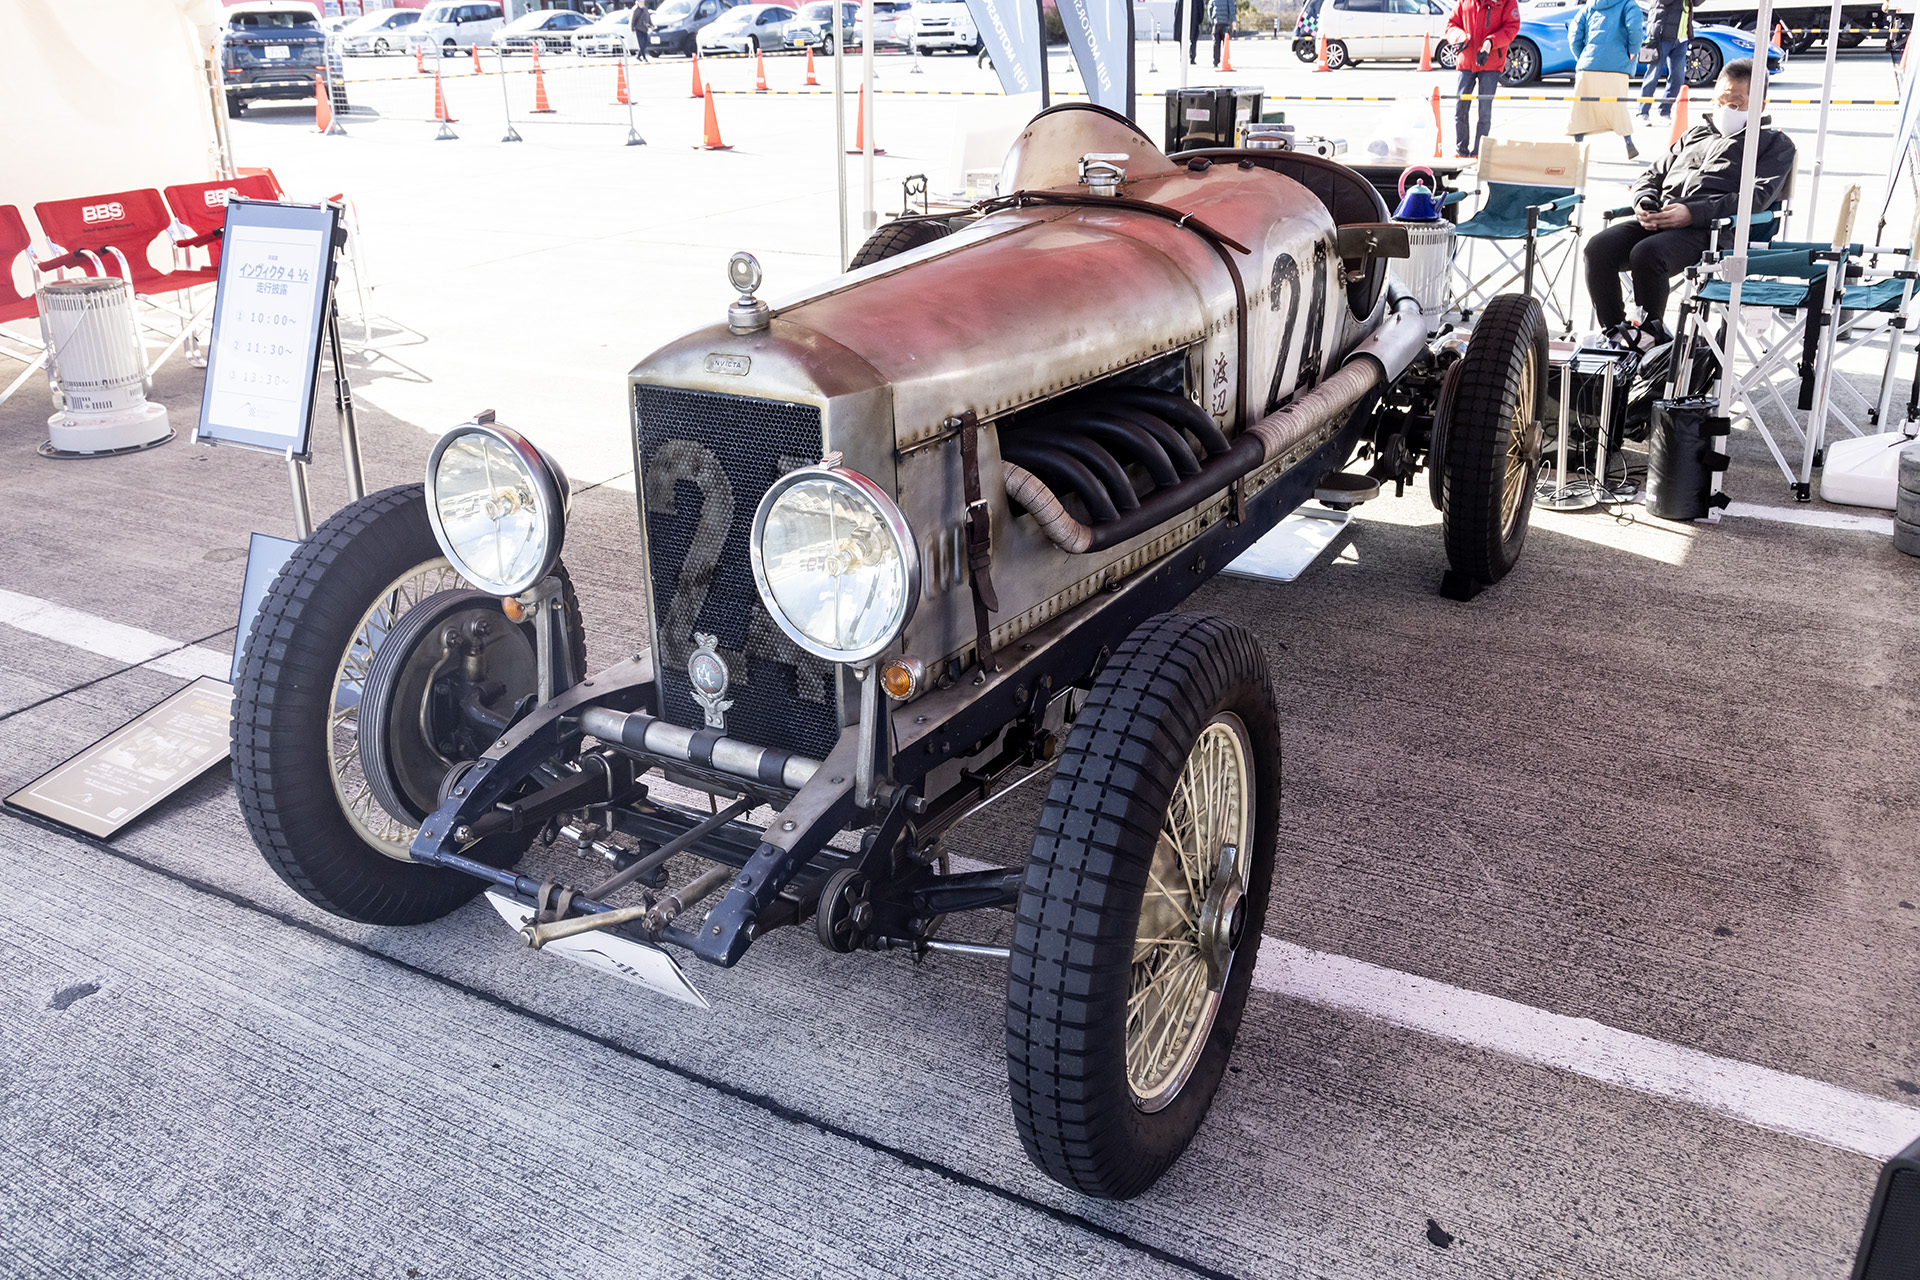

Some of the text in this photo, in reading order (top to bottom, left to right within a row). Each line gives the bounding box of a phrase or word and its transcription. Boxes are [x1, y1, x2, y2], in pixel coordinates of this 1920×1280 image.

[82, 202, 126, 224] BBS
[239, 262, 285, 279] インヴィクタ
[287, 267, 295, 280] 4
[256, 281, 288, 296] 走行披露
